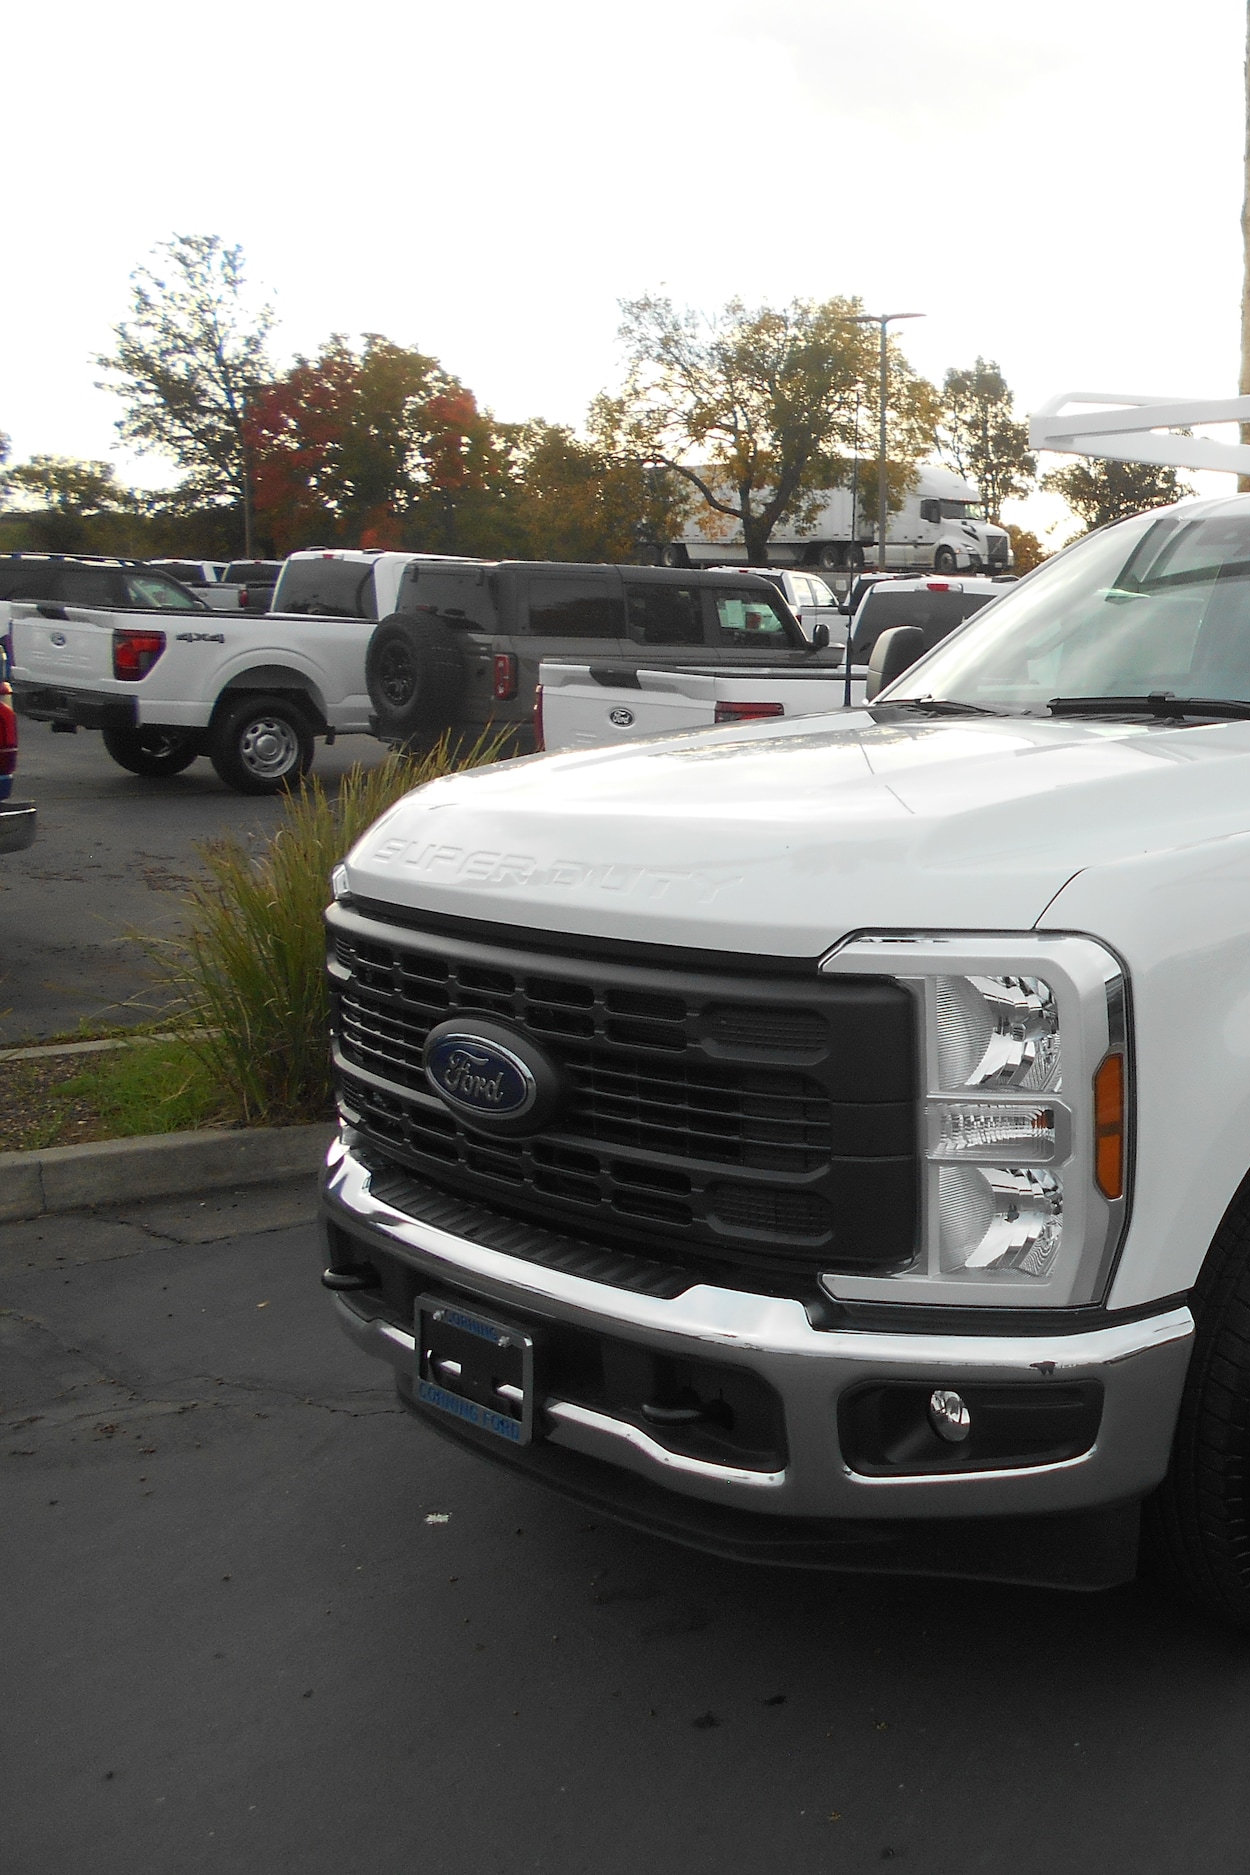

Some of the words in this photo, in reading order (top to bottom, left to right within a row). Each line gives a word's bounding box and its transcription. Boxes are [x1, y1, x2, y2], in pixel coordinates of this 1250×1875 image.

[373, 838, 538, 884] SUPER
[546, 859, 745, 905] DUTY
[445, 1049, 504, 1103] Ford
[418, 1381, 479, 1424] CORNING
[482, 1410, 521, 1442] FORD
